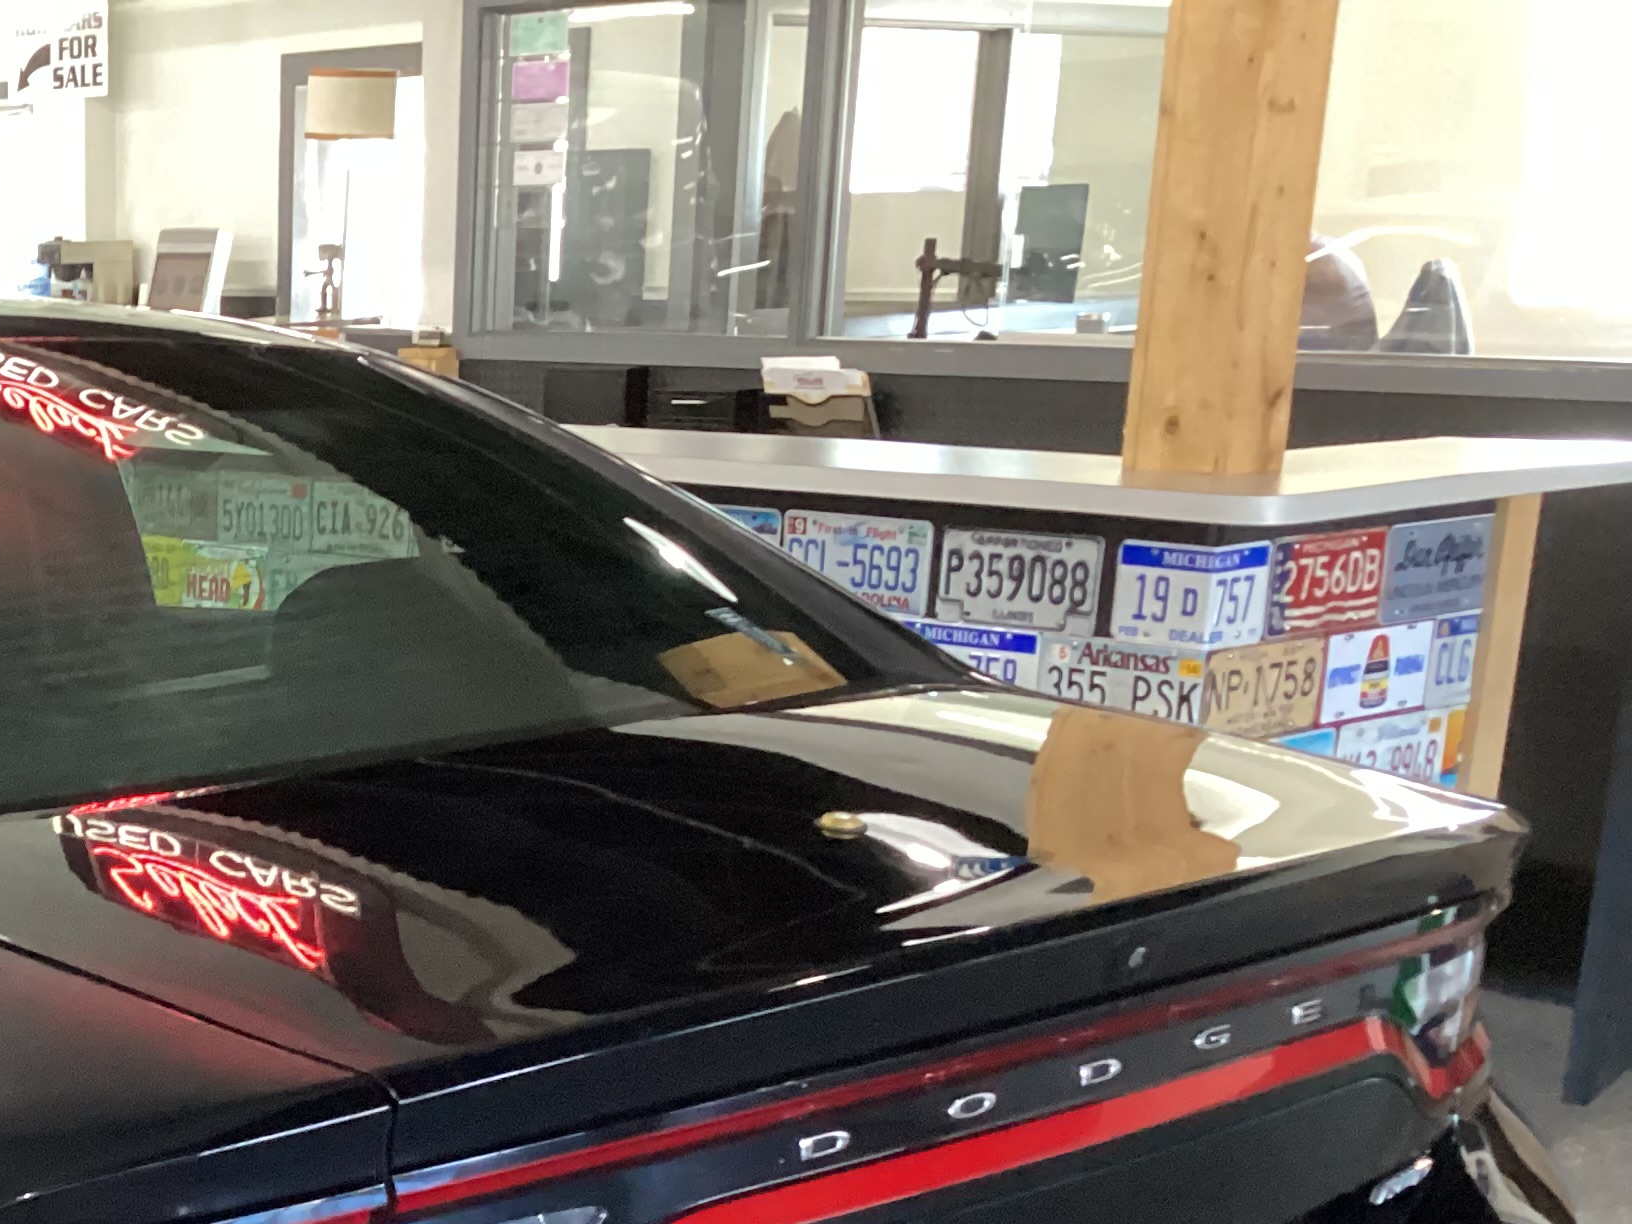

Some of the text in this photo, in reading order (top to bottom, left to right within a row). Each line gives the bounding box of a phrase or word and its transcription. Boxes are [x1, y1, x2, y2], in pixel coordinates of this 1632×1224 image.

[58, 34, 98, 61] FOR
[53, 62, 104, 90] SALE
[1161, 550, 1242, 569] MICHIGAN
[943, 548, 1090, 608] P359088
[1131, 573, 1256, 629] 19 D 757
[923, 625, 1001, 647] MICHIGAN
[1077, 641, 1172, 675] Arkansas
[1131, 674, 1201, 724] PSK
[798, 999, 1322, 1162] DODGE
